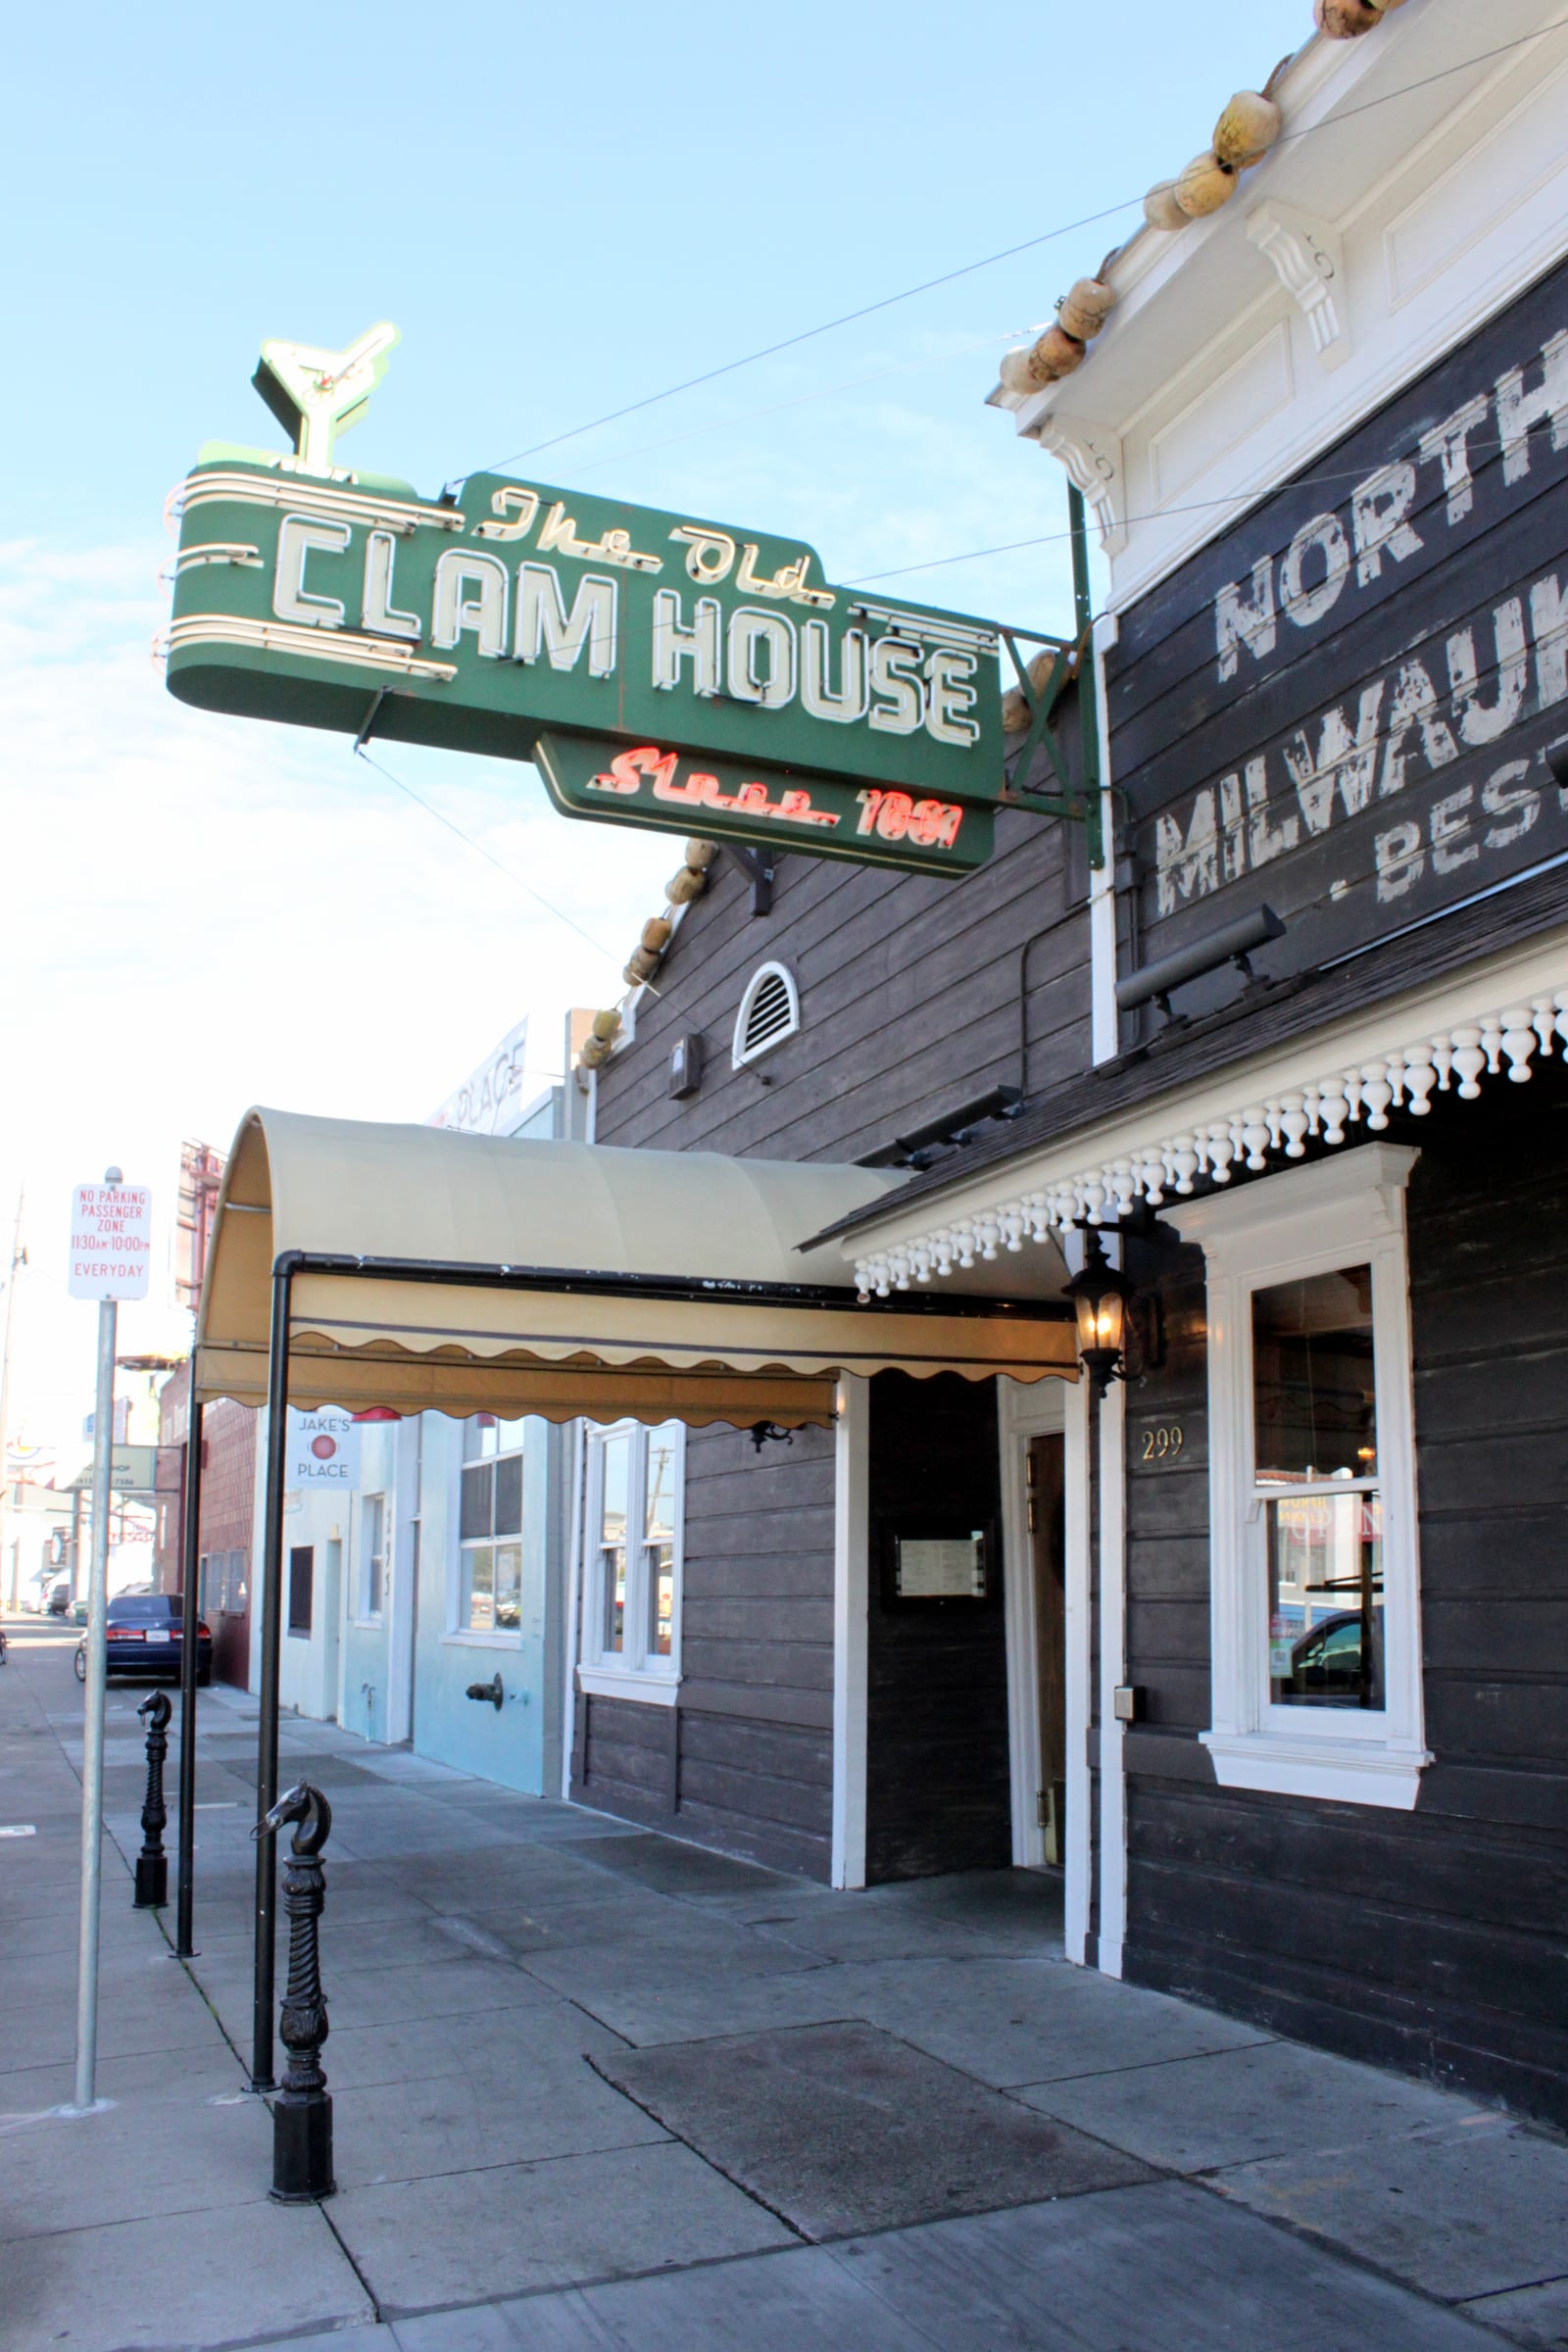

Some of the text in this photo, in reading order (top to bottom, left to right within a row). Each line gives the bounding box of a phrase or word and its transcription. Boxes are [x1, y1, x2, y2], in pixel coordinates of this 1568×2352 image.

[1214, 327, 1568, 683] NORTH
[470, 486, 835, 611] The Old
[273, 513, 980, 748] CLAM HOUSE
[586, 747, 963, 850] Since 1861
[79, 1190, 145, 1205] NO PARKING
[81, 1204, 143, 1219] PASSENGER
[98, 1219, 125, 1233] ZONE
[74, 1263, 144, 1278] EVERYDAY
[298, 1418, 351, 1433] JAKE'S
[1142, 1426, 1184, 1461] 299
[297, 1463, 350, 1479] PLACE
